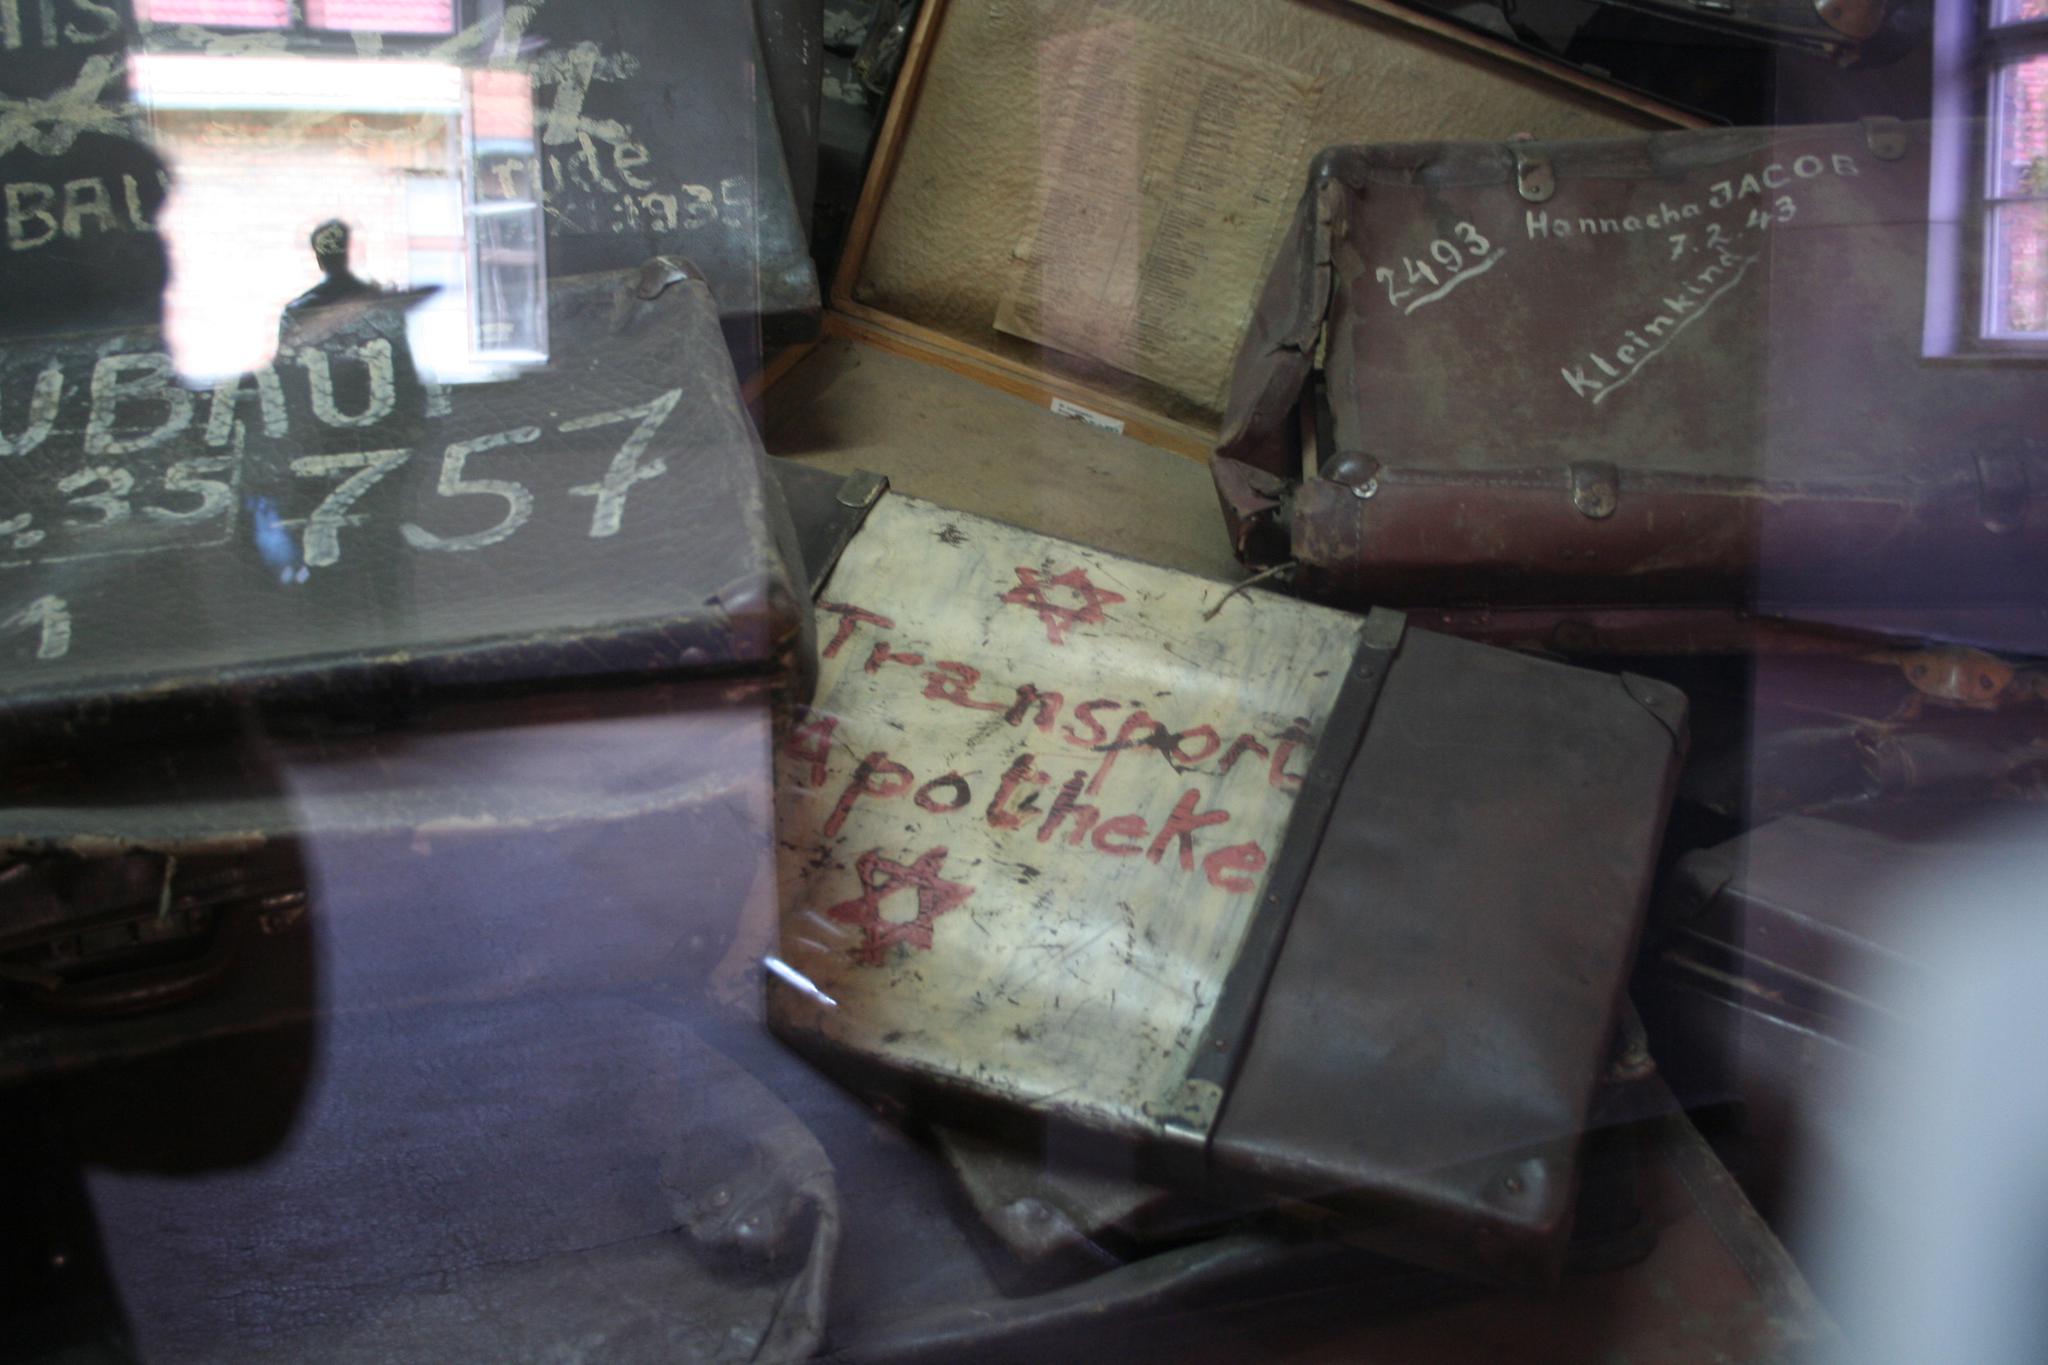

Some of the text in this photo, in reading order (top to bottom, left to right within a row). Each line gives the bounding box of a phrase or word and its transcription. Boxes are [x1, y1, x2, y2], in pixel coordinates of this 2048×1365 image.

[1709, 154, 1860, 209] JACOB
[1376, 221, 1491, 306] 2493
[815, 600, 1312, 795] Transport
